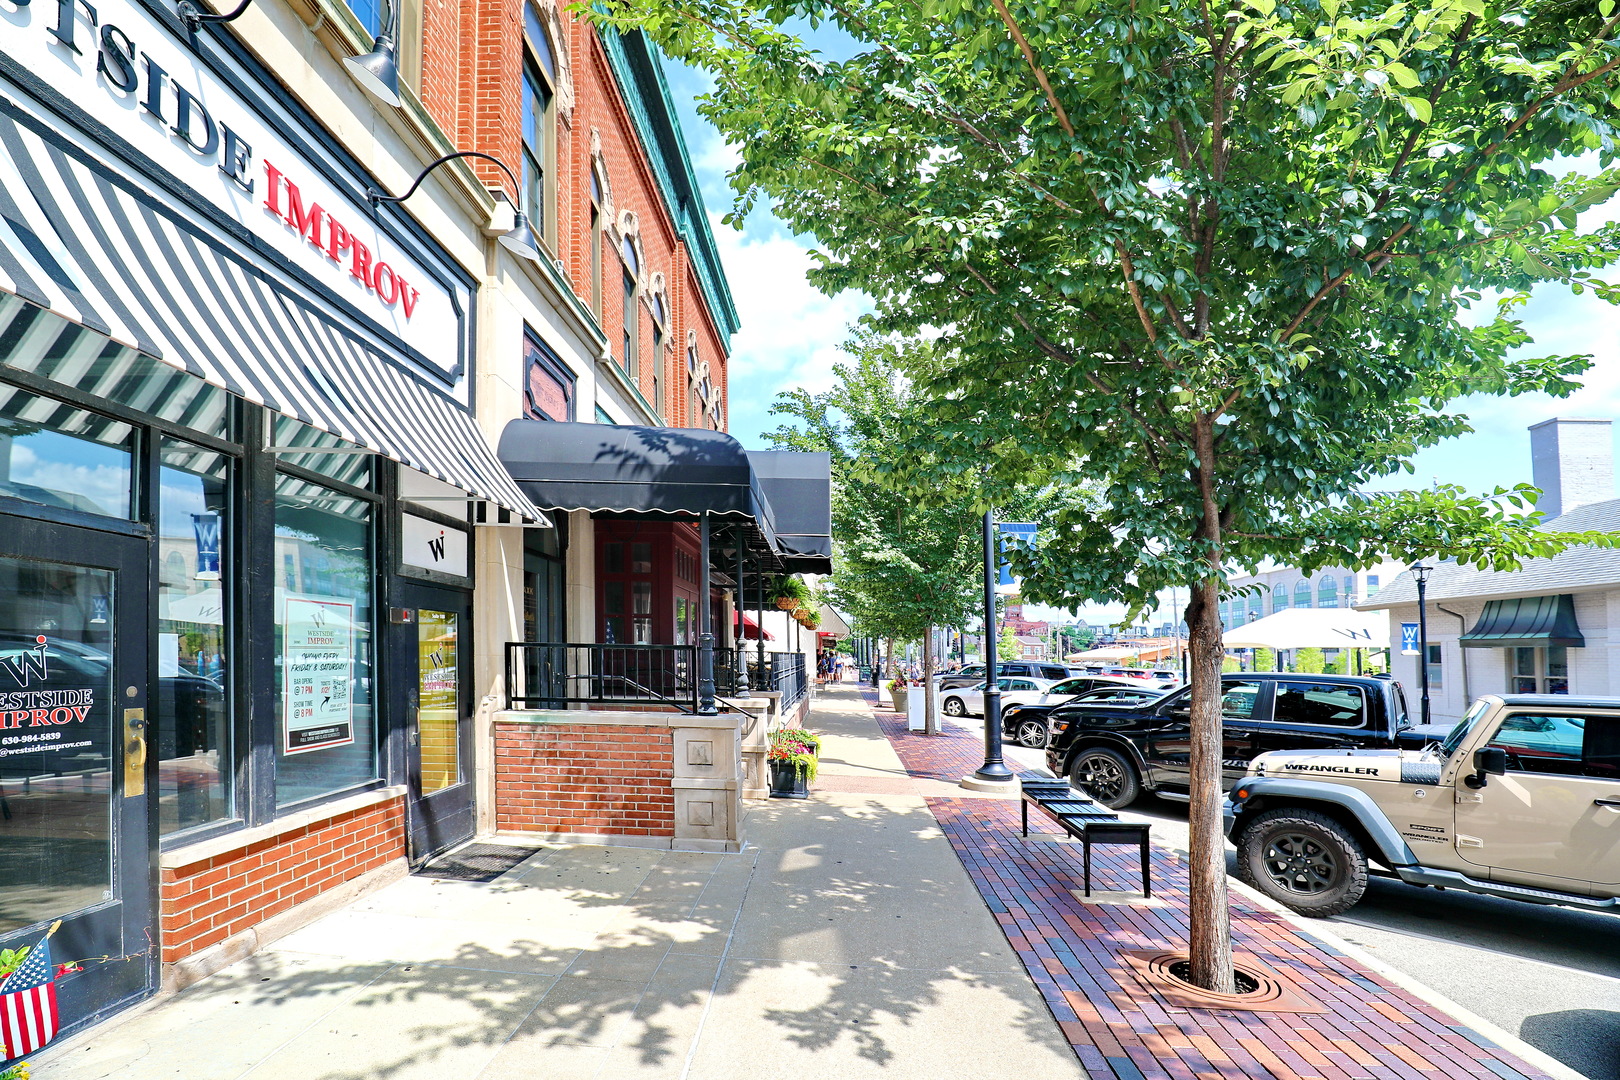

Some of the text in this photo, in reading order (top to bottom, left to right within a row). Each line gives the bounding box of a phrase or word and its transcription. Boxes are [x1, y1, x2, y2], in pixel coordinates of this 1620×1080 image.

[0, 0, 420, 319] TSIDE IMPROV
[1402, 626, 1418, 639] W
[307, 637, 334, 645] IMPROV
[291, 663, 312, 672] FRIDAY
[319, 663, 347, 671] SATURDAY!
[294, 686, 313, 695] @ 7 PM
[294, 708, 313, 718] @ 8 PM
[2, 732, 61, 745] 630-984-5839
[1285, 763, 1379, 776] WRANGLER
[1402, 832, 1449, 841] WRANGLER
